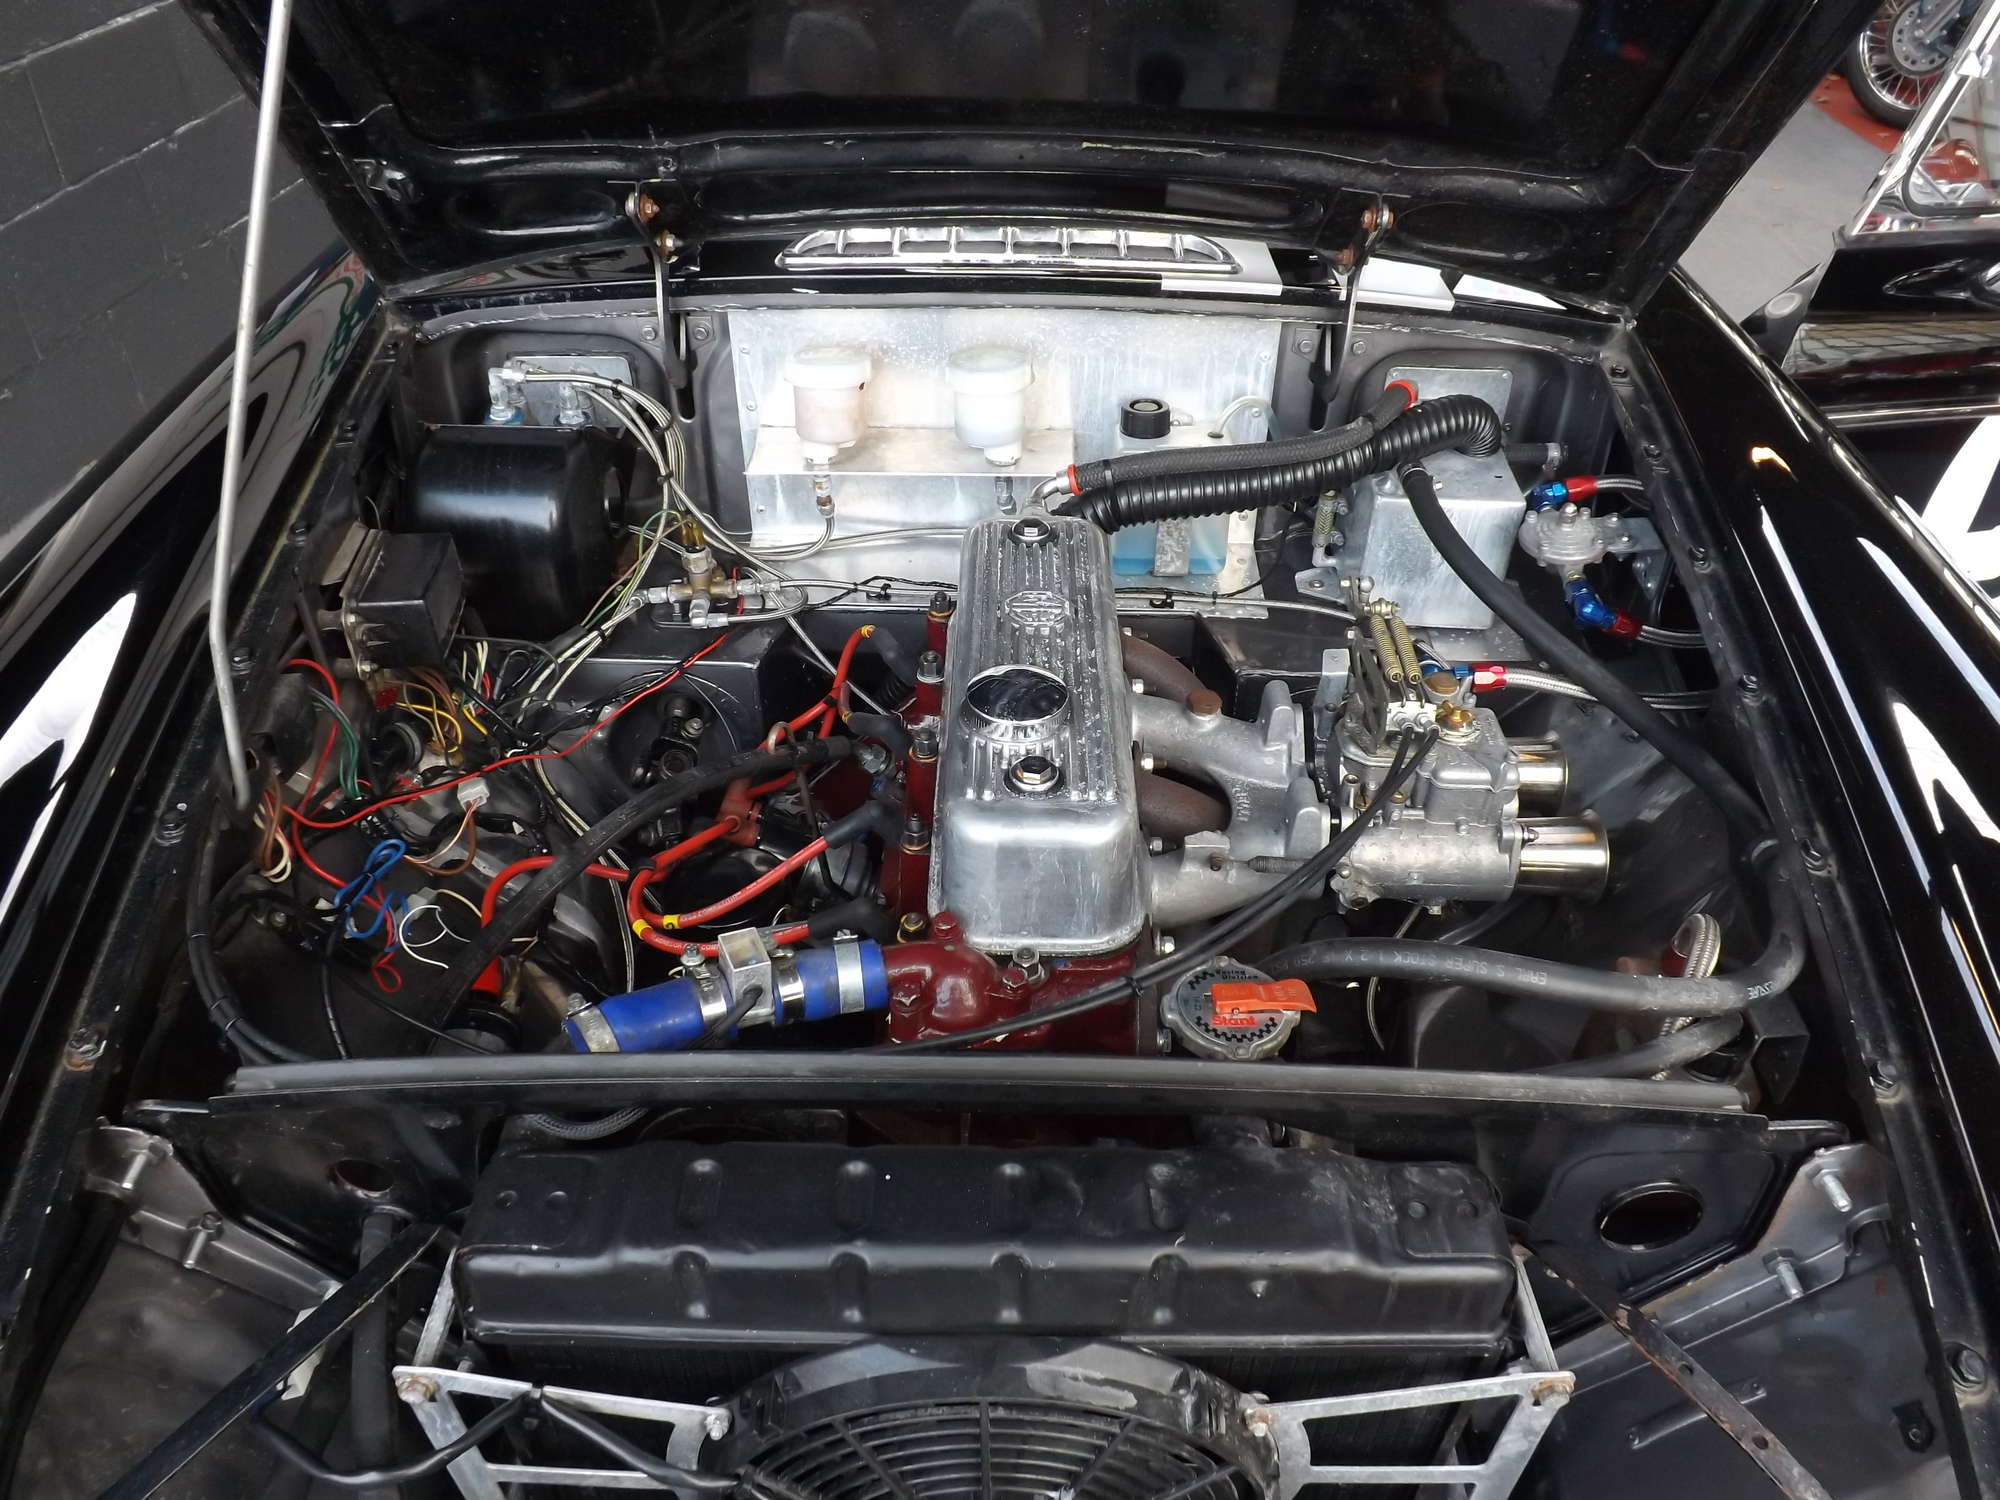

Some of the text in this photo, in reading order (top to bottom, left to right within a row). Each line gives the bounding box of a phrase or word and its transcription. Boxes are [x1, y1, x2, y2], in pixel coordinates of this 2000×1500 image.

[1393, 950, 1437, 967] STOCK
[1445, 957, 1488, 975] SUPER
[1215, 968, 1246, 976] Racing
[1516, 967, 1547, 985] EARL
[1211, 1015, 1257, 1026] Stant
